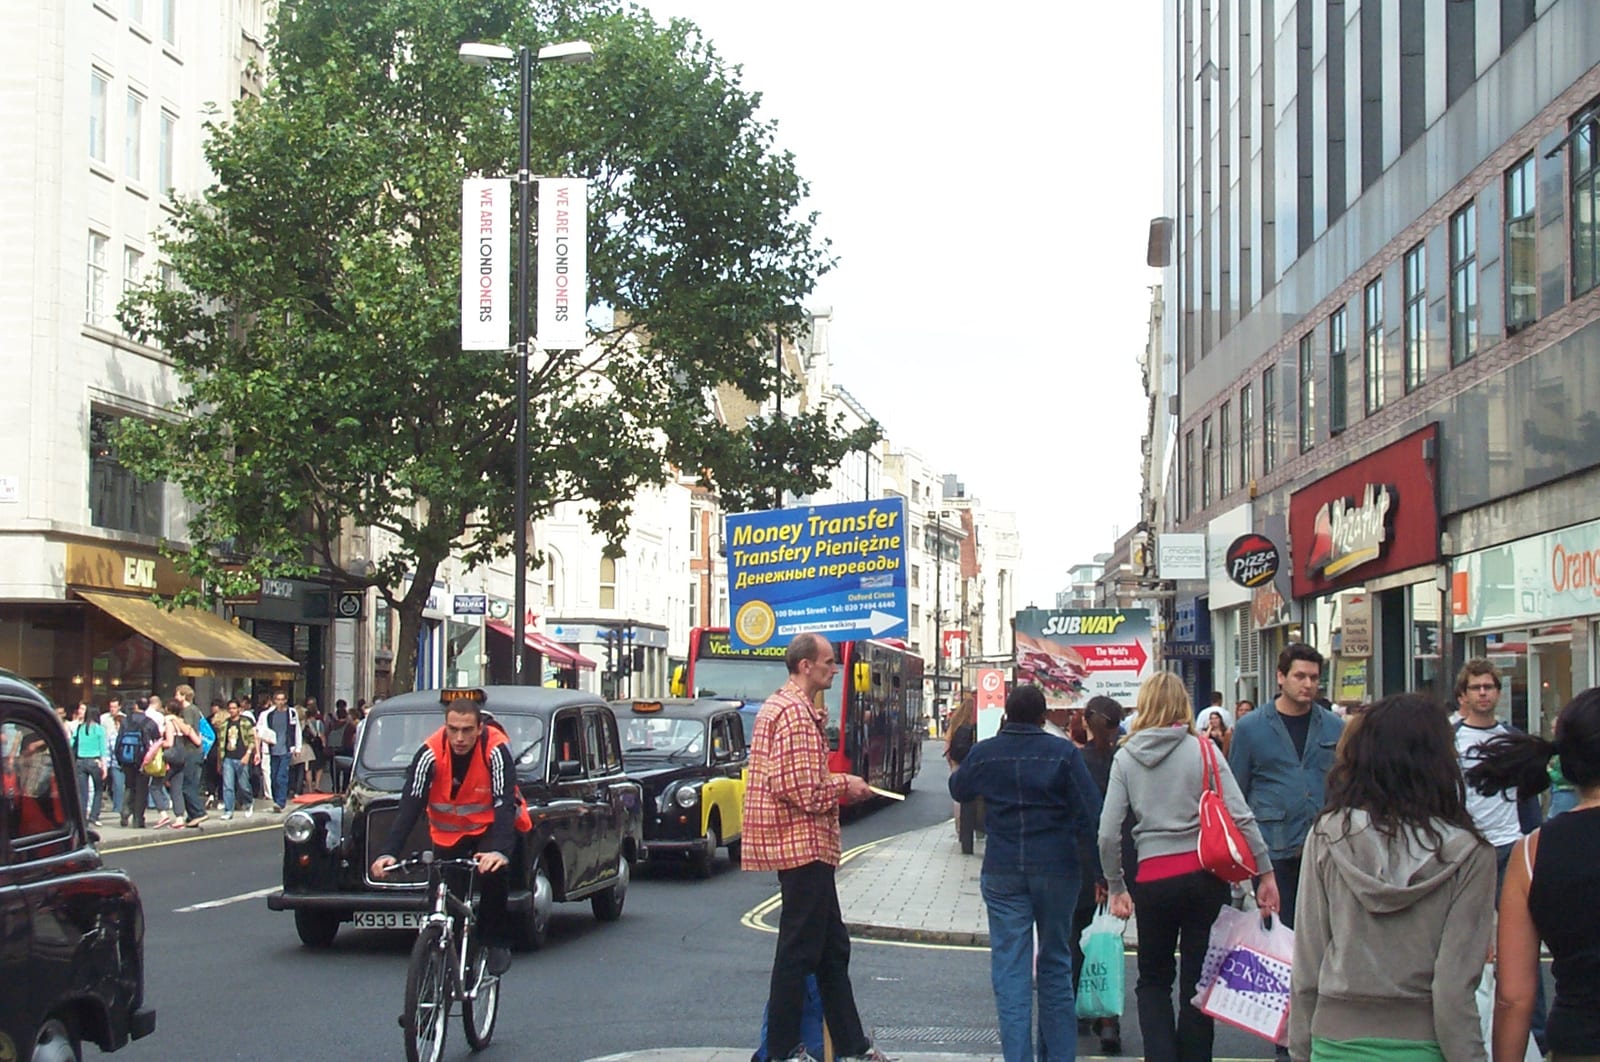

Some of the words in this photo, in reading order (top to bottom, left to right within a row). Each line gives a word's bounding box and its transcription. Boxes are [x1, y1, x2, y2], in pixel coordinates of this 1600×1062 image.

[480, 187, 493, 207] WE
[556, 187, 569, 207] WE
[480, 210, 493, 234] ARE
[555, 209, 569, 233] ARE
[479, 237, 493, 322] LONDONERS
[555, 237, 569, 322] LONDONERS
[732, 523, 803, 547] Money
[807, 508, 898, 537] Transfer
[733, 544, 812, 568] Transfery
[815, 534, 900, 558] Pieniężne
[735, 566, 816, 590] Денежные
[819, 555, 900, 579] переводы
[1232, 551, 1276, 579] Pizza
[1241, 562, 1272, 583] Hut
[455, 600, 485, 608] HALIFAX
[848, 592, 872, 601] Oxford
[873, 591, 895, 600] Circus
[788, 608, 805, 617] Dean
[806, 607, 827, 615] Street
[832, 604, 844, 613] Tel:
[781, 625, 798, 633] Only
[803, 623, 827, 631] minute
[829, 621, 857, 630] walking
[1042, 614, 1126, 636] SUBWAY
[1095, 647, 1107, 656] The
[1107, 646, 1129, 656] World's
[1175, 644, 1212, 656] HOUSE
[1345, 644, 1369, 654] £5.99
[1086, 658, 1112, 666] Favourite
[1112, 657, 1139, 666] Sandwich
[354, 914, 396, 927] K933
